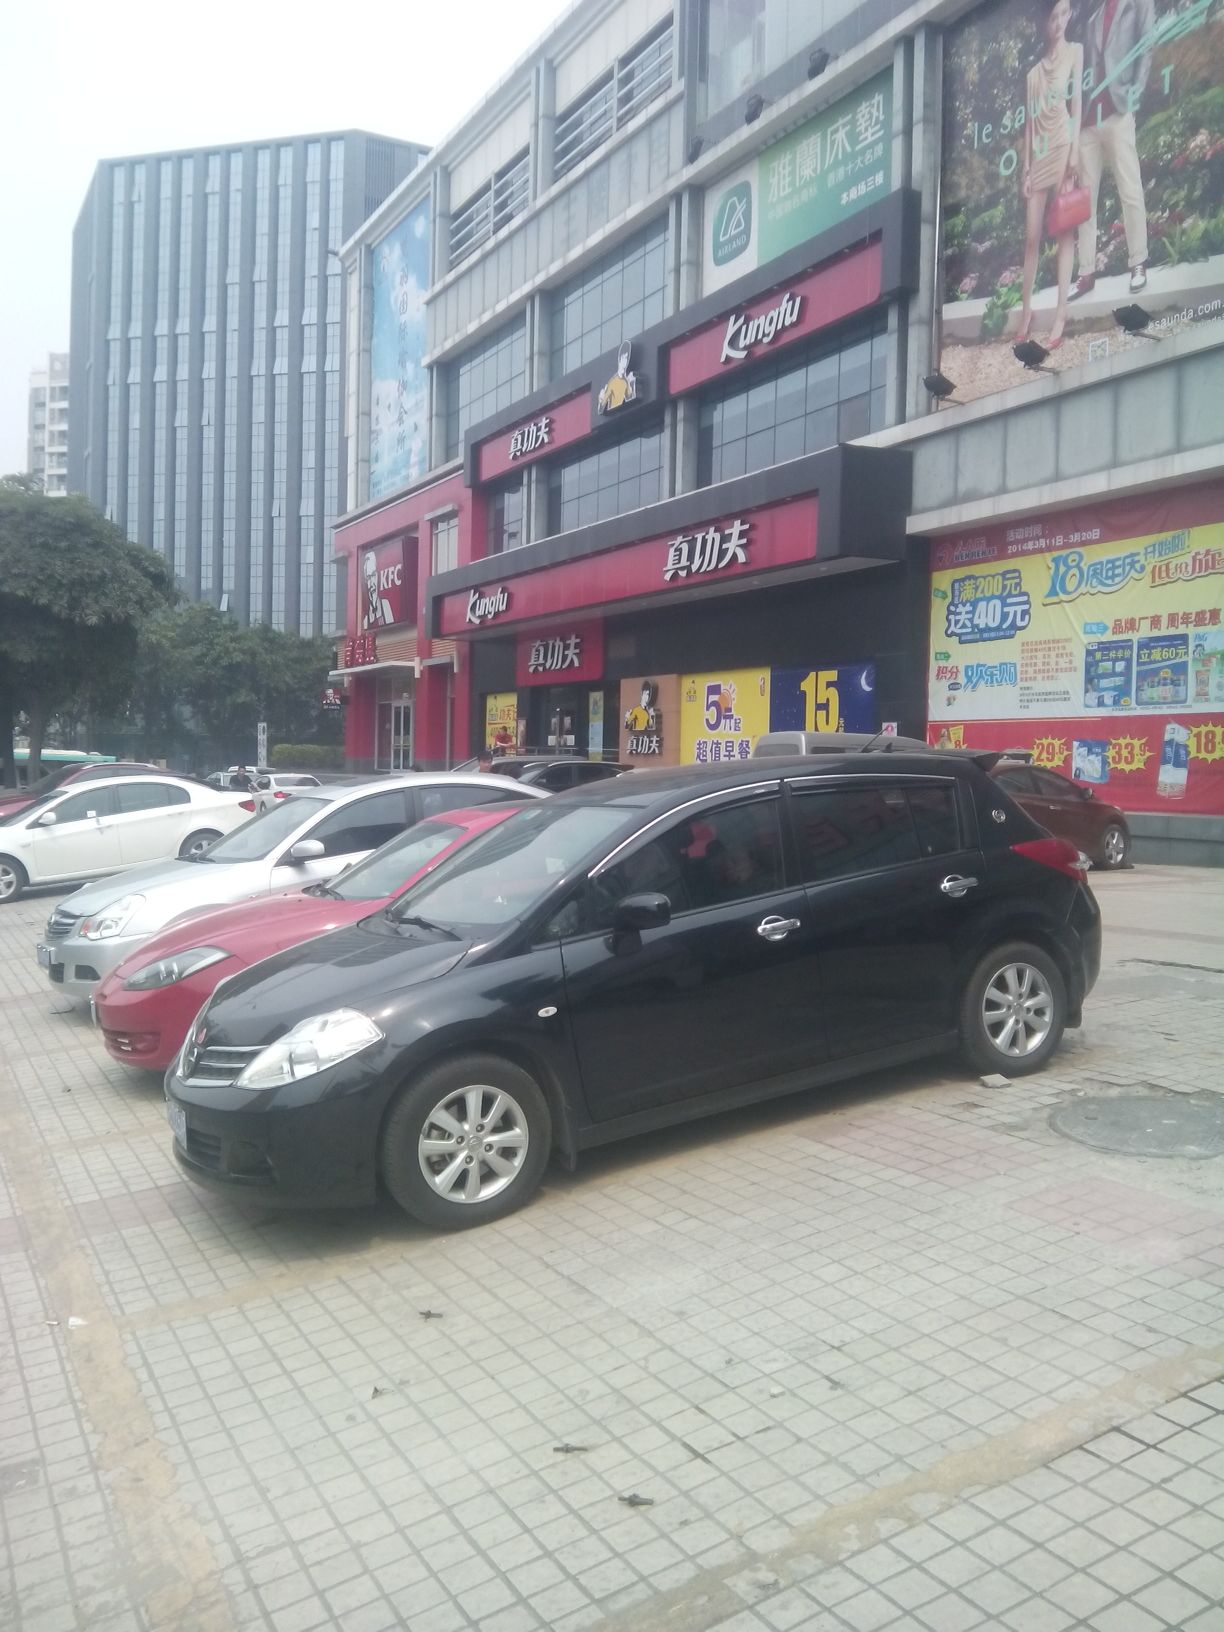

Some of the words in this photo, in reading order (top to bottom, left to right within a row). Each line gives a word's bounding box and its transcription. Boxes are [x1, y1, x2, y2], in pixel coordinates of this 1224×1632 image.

[717, 233, 748, 259] AIRLAND
[719, 292, 802, 364] Kungfu
[508, 416, 551, 460] 真功夫
[663, 518, 751, 582] 真功夫
[379, 564, 403, 591] KFC
[960, 571, 1021, 602] 满200元
[466, 586, 508, 625] Kungfu
[948, 595, 1030, 634] 送40元
[528, 634, 582, 674] 真功夫
[800, 669, 840, 732] 15
[626, 734, 661, 755] 真功夫
[695, 739, 752, 763] 超值早餐
